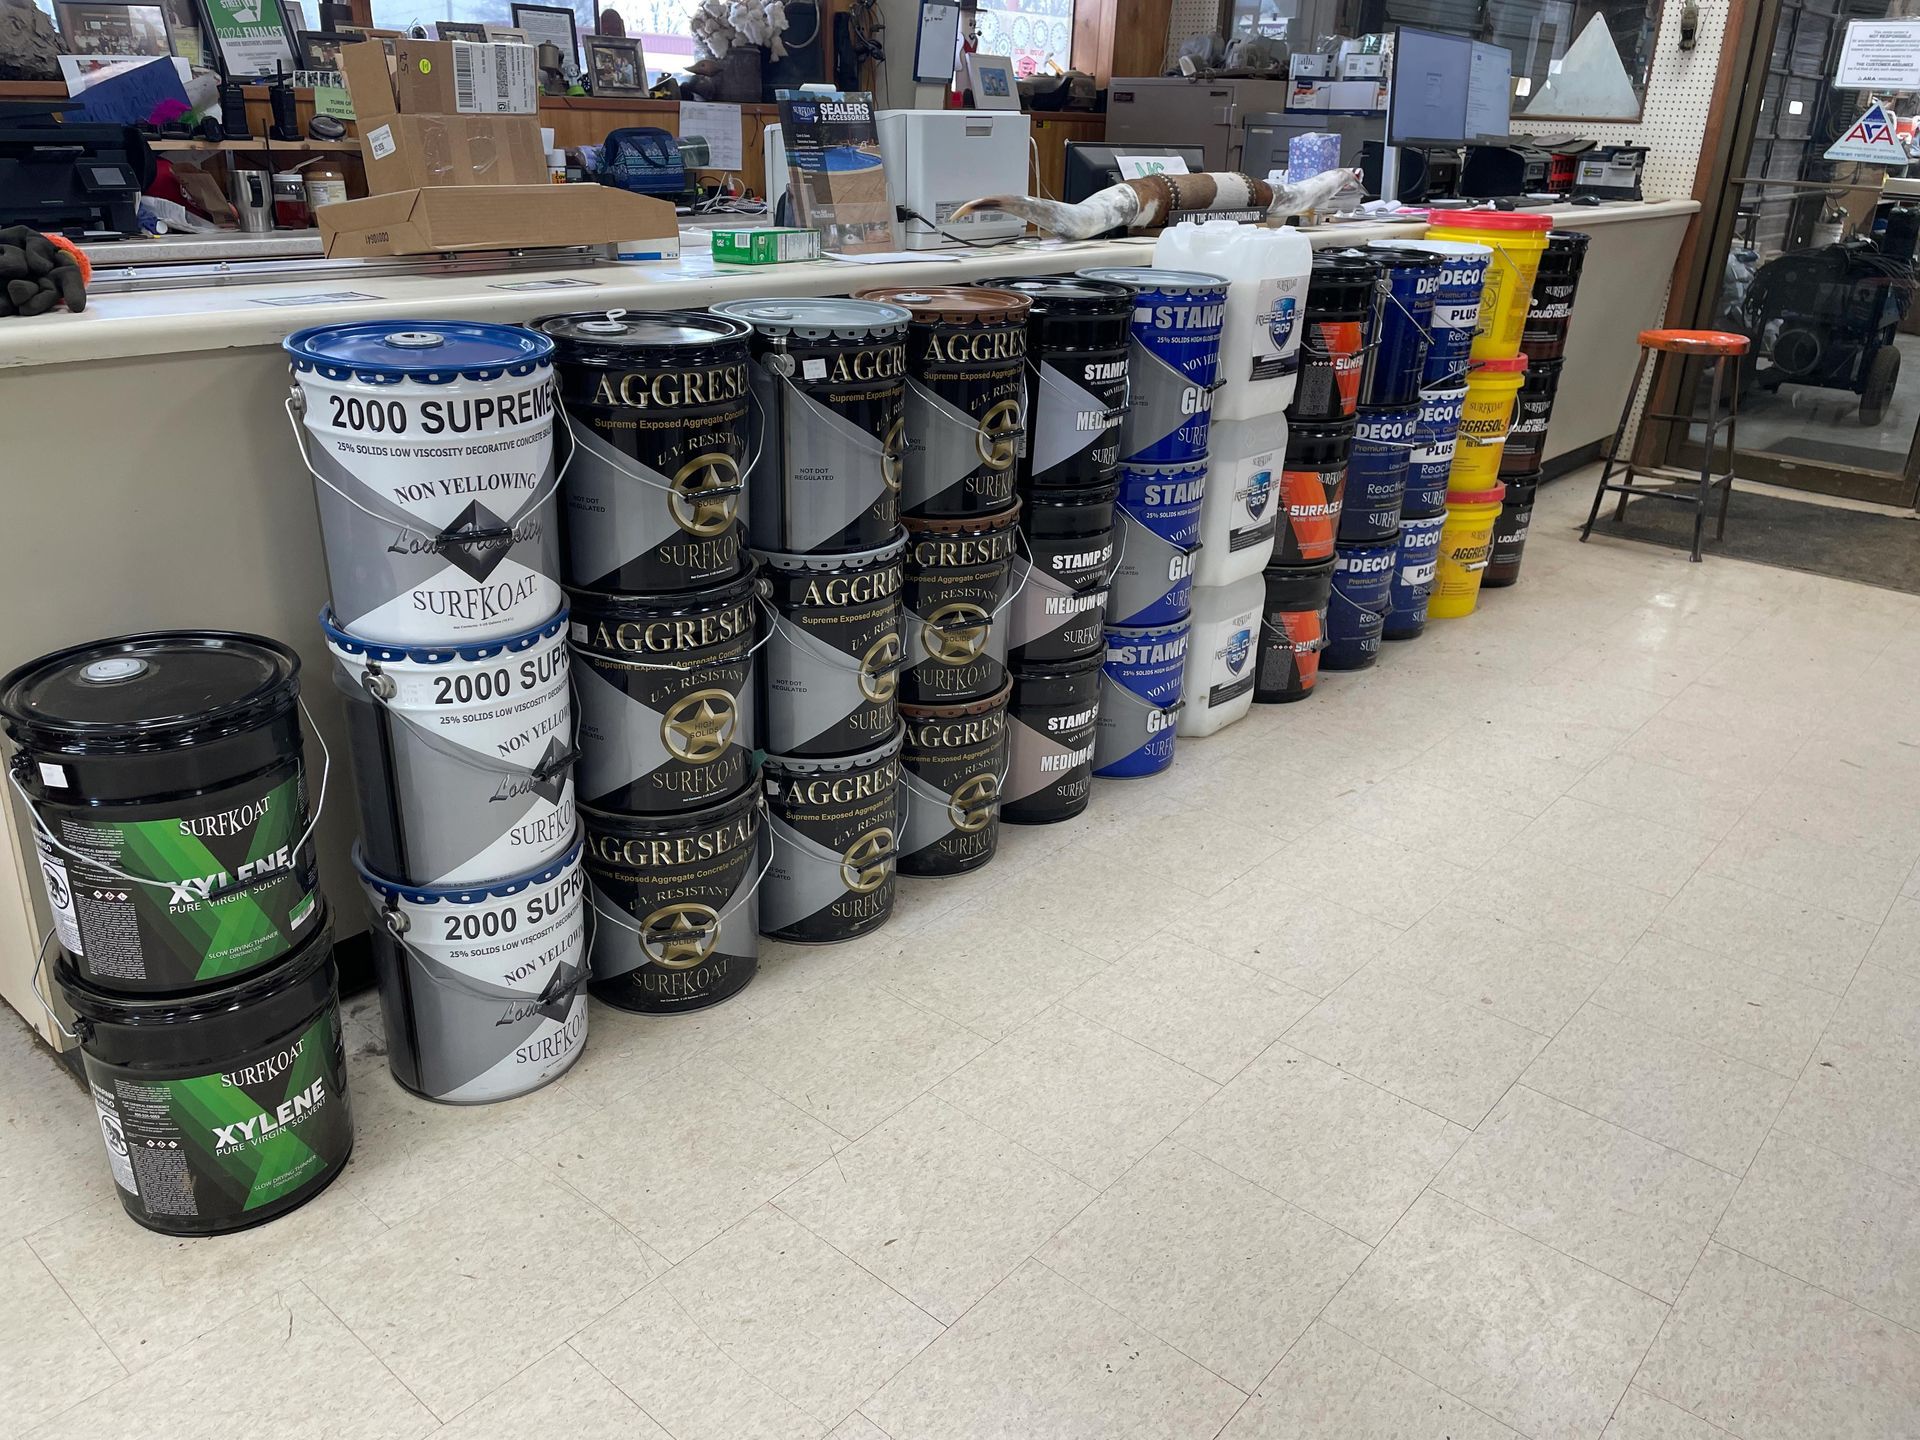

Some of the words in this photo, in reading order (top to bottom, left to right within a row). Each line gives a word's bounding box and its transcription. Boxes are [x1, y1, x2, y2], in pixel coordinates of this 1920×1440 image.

[217, 28, 241, 38] 2024
[242, 26, 283, 38] FINALIST
[820, 103, 870, 114] SEALERS
[1196, 213, 1207, 224] THE
[1208, 212, 1226, 222] CHAOS
[1226, 210, 1260, 222] COORDINATOR
[1440, 268, 1479, 286] DECO
[1450, 308, 1477, 321] PLUS
[1526, 310, 1552, 318] LIQUID
[1546, 302, 1569, 311] ANTIQUE
[1155, 304, 1224, 329] STAMP
[1273, 322, 1290, 335] 309
[1171, 336, 1190, 344] SOLIDS
[1084, 362, 1126, 380] STAMP
[1182, 357, 1202, 372] NON
[923, 371, 958, 381] Supreme
[960, 370, 990, 382] Exposed
[829, 393, 865, 404] Supreme
[866, 390, 892, 402] Exposed
[329, 394, 408, 434] 2000
[420, 382, 552, 434] SUPREME
[1417, 406, 1453, 422] DECO
[594, 418, 637, 430] Supreme
[640, 419, 681, 430] Exposed
[683, 415, 724, 429] Aggregate
[1356, 423, 1402, 439] DECO
[337, 441, 355, 454] 25%
[356, 444, 388, 457] SOLIDS
[390, 446, 410, 458] LOW
[412, 448, 464, 458] VISCOSITY
[466, 440, 516, 456] DECORATIVE
[516, 432, 542, 448] CONCRETE
[1426, 444, 1454, 457] PLUS
[393, 480, 436, 504] NON
[438, 472, 536, 497] YELLOWING
[1144, 478, 1206, 506] STAMP
[1250, 494, 1266, 507] 309
[1290, 500, 1340, 516] SURFACE
[1170, 528, 1188, 542] NON
[1404, 533, 1439, 548] DECO
[1498, 535, 1518, 544] LIQUID
[1052, 550, 1100, 570] STAMP
[1350, 558, 1390, 573] DECO
[937, 574, 974, 584] Aggregate
[413, 574, 538, 622] SURFKOAT
[940, 588, 998, 602] RESISTANT
[1045, 596, 1098, 615] MEDIUM
[802, 616, 838, 626] Supreme
[840, 612, 871, 624] Exposed
[1121, 638, 1184, 665] STAMP
[594, 658, 632, 672] Supreme
[1136, 668, 1154, 676] SOLIDS
[680, 670, 744, 690] RESISTANT
[912, 662, 993, 691] SURFKOAT
[434, 668, 510, 705] 2000
[1147, 684, 1166, 698] NON
[440, 716, 460, 724] 25%
[462, 711, 494, 723] SOLIDS
[495, 706, 513, 718] LOW
[514, 695, 548, 714] VISCOSITY
[694, 720, 716, 731] HIGH
[1048, 709, 1091, 732] STAMP
[690, 726, 719, 738] SOLIDS
[496, 732, 531, 758] NON
[932, 755, 962, 764] Exposed
[962, 748, 990, 761] Aggregate
[1040, 747, 1087, 772] MEDIUM
[652, 752, 744, 794] SURFKOAT
[178, 796, 271, 838] SURFKOAT
[786, 811, 820, 821] Supreme
[822, 811, 854, 822] Exposed
[854, 800, 883, 816] Aggregate
[614, 872, 650, 884] Exposed
[650, 874, 696, 886] Aggregate
[696, 862, 729, 878] Concrete
[168, 901, 202, 915] PURE
[208, 889, 248, 908] VIRGIN
[656, 886, 730, 902] RESISTANT
[444, 906, 518, 942] 2000
[208, 950, 229, 960] SLOW
[229, 940, 253, 956] DRYING
[250, 930, 280, 948] THINNER
[450, 950, 469, 958] 25%
[470, 945, 500, 958] SOLIDS
[502, 940, 520, 952] LOW
[521, 926, 554, 947] VISCOSITY
[229, 949, 250, 960] CONTAINS
[250, 944, 264, 954] VOC
[503, 960, 536, 986] NON
[632, 958, 731, 996] SURFKOAT
[220, 1038, 305, 1089] SURFKOAT
[210, 1076, 326, 1150] XYLENE
[216, 1142, 246, 1157] PURE
[250, 1126, 288, 1147] VIRGIN
[292, 1097, 326, 1128] SOLVENT
[254, 1179, 272, 1192] SLOW
[271, 1169, 296, 1186] DRYING
[292, 1154, 318, 1174] THINNER
